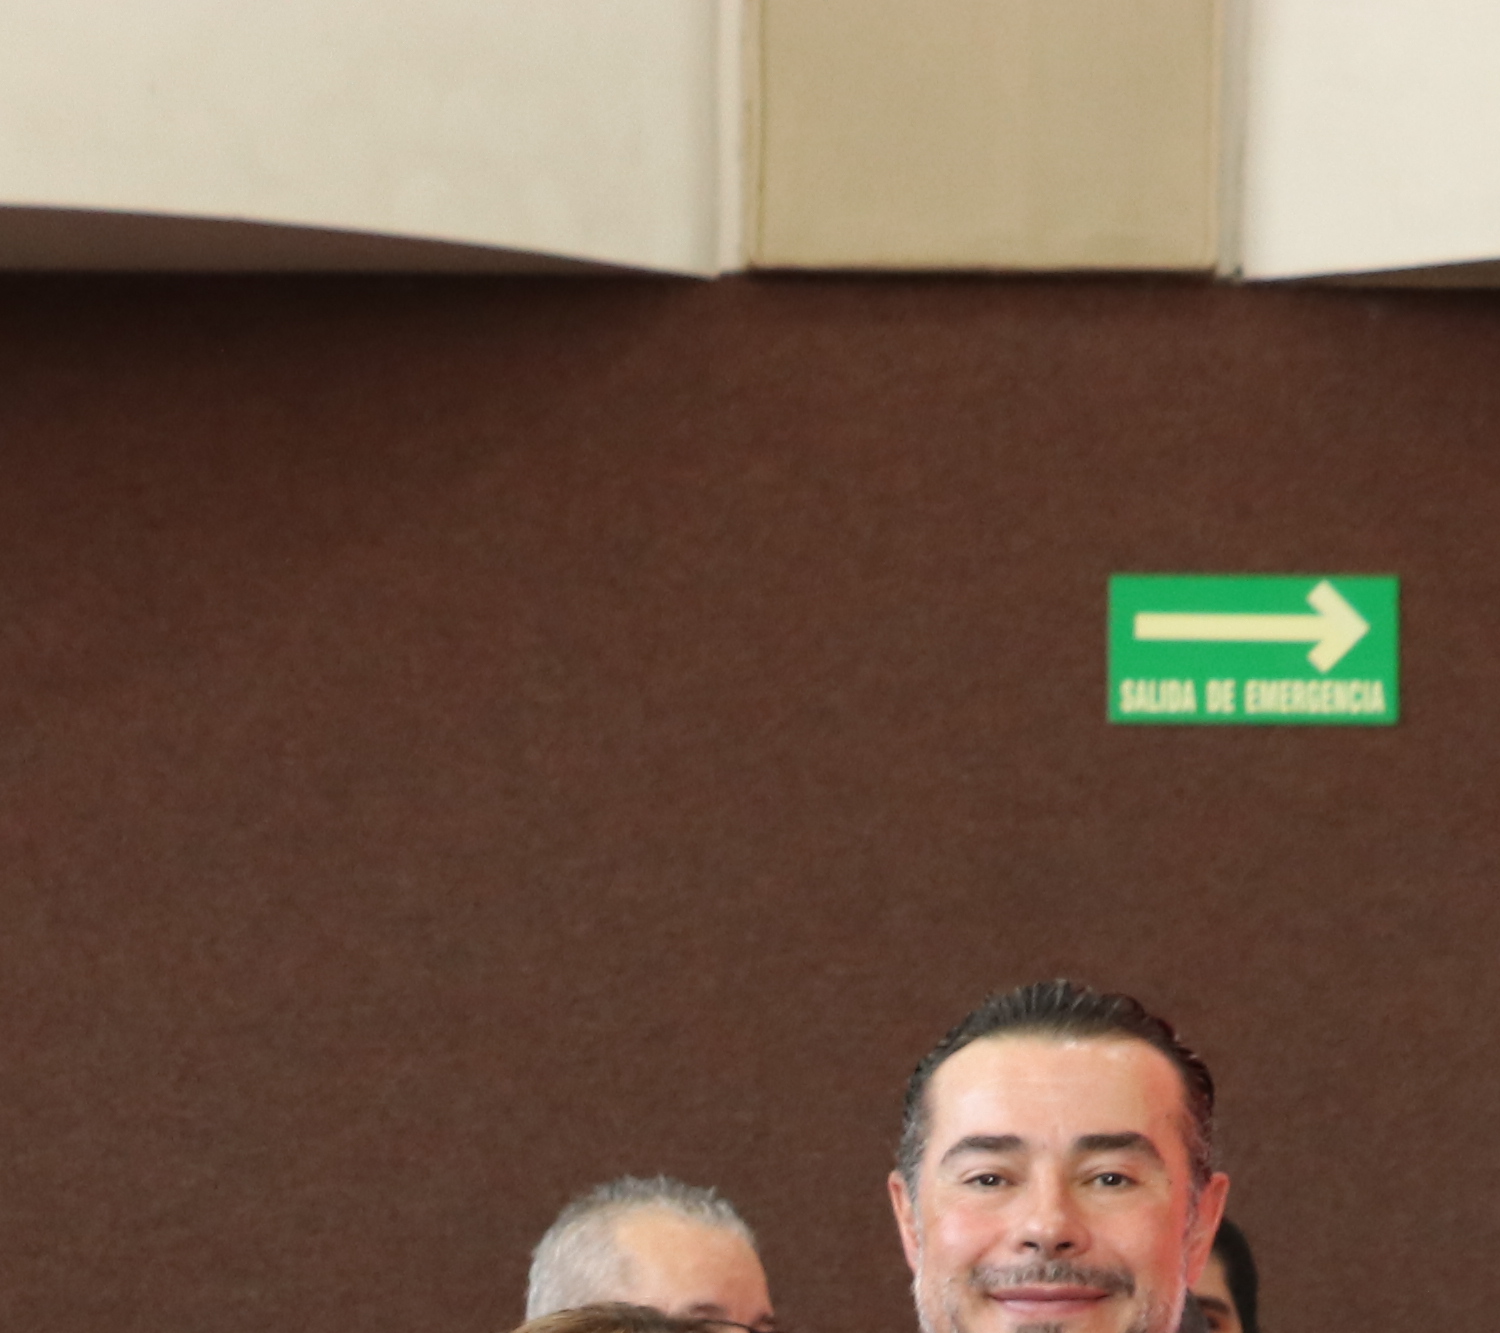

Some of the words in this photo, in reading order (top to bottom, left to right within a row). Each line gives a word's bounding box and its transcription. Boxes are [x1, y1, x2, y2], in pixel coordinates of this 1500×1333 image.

[1119, 678, 1197, 713] SALIDA
[1206, 680, 1236, 713] DE
[1245, 679, 1385, 714] EMERGENCIA
